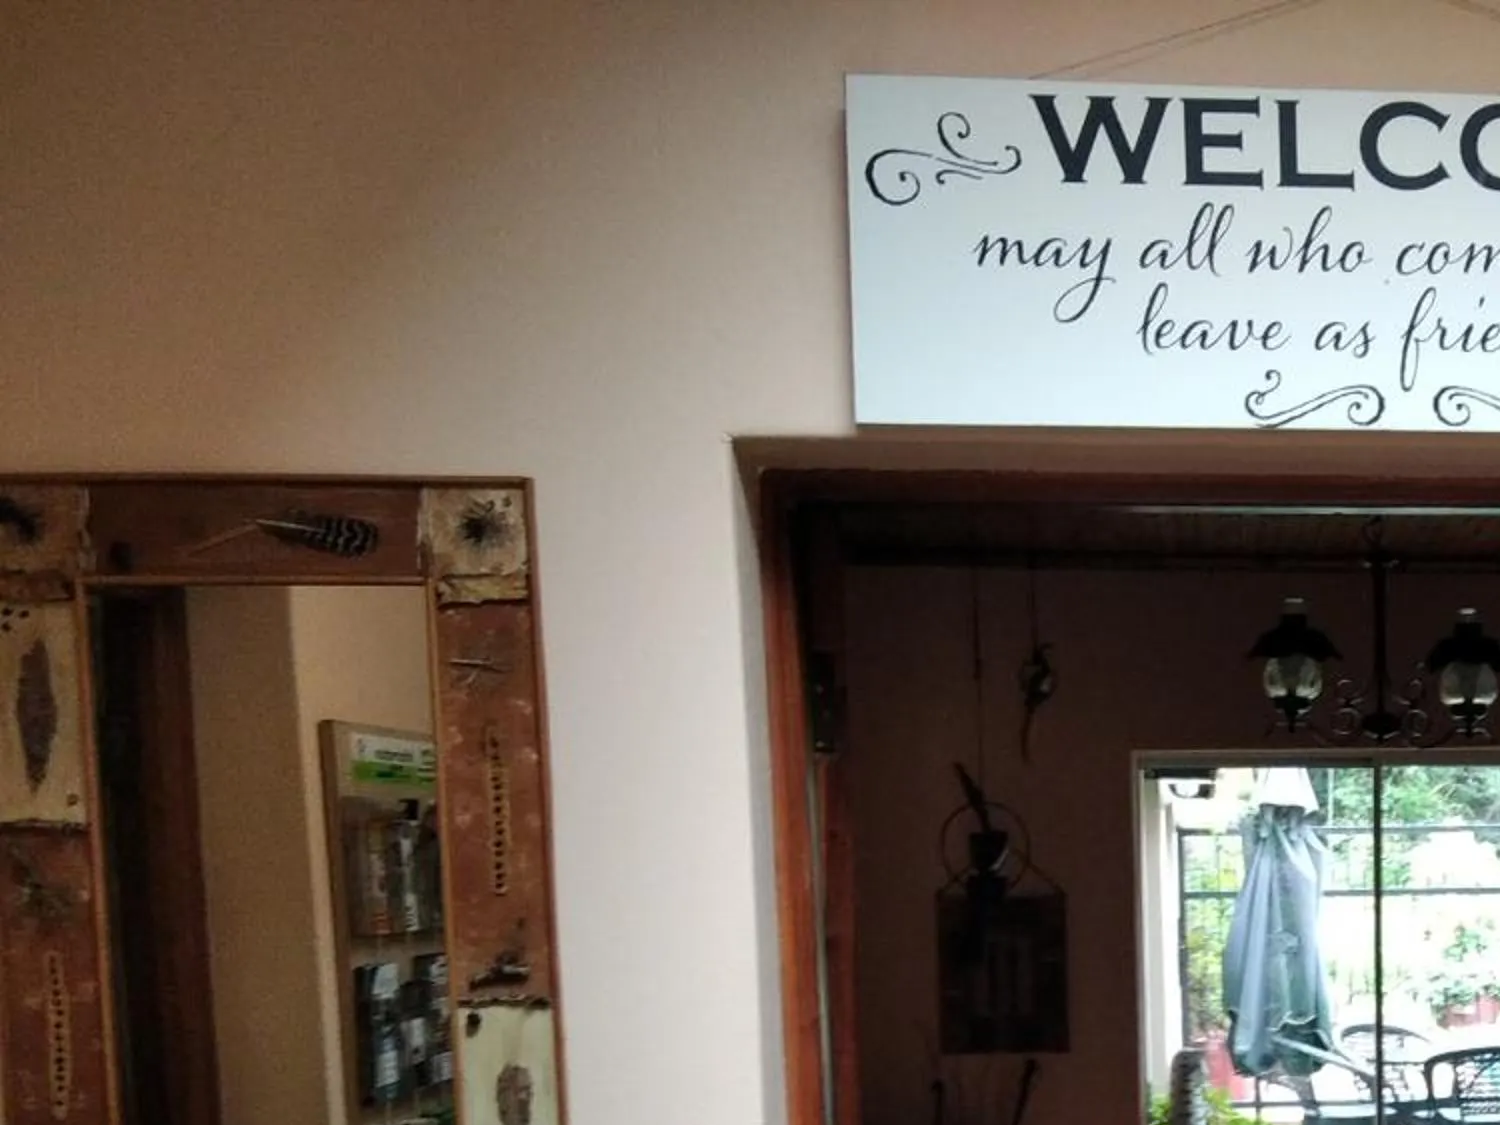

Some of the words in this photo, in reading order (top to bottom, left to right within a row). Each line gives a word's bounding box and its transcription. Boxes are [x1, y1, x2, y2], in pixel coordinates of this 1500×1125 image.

[973, 230, 1116, 323] may
[1138, 202, 1235, 277] all
[1247, 206, 1373, 275] who
[1135, 282, 1293, 356] leave
[1313, 320, 1377, 359] as
